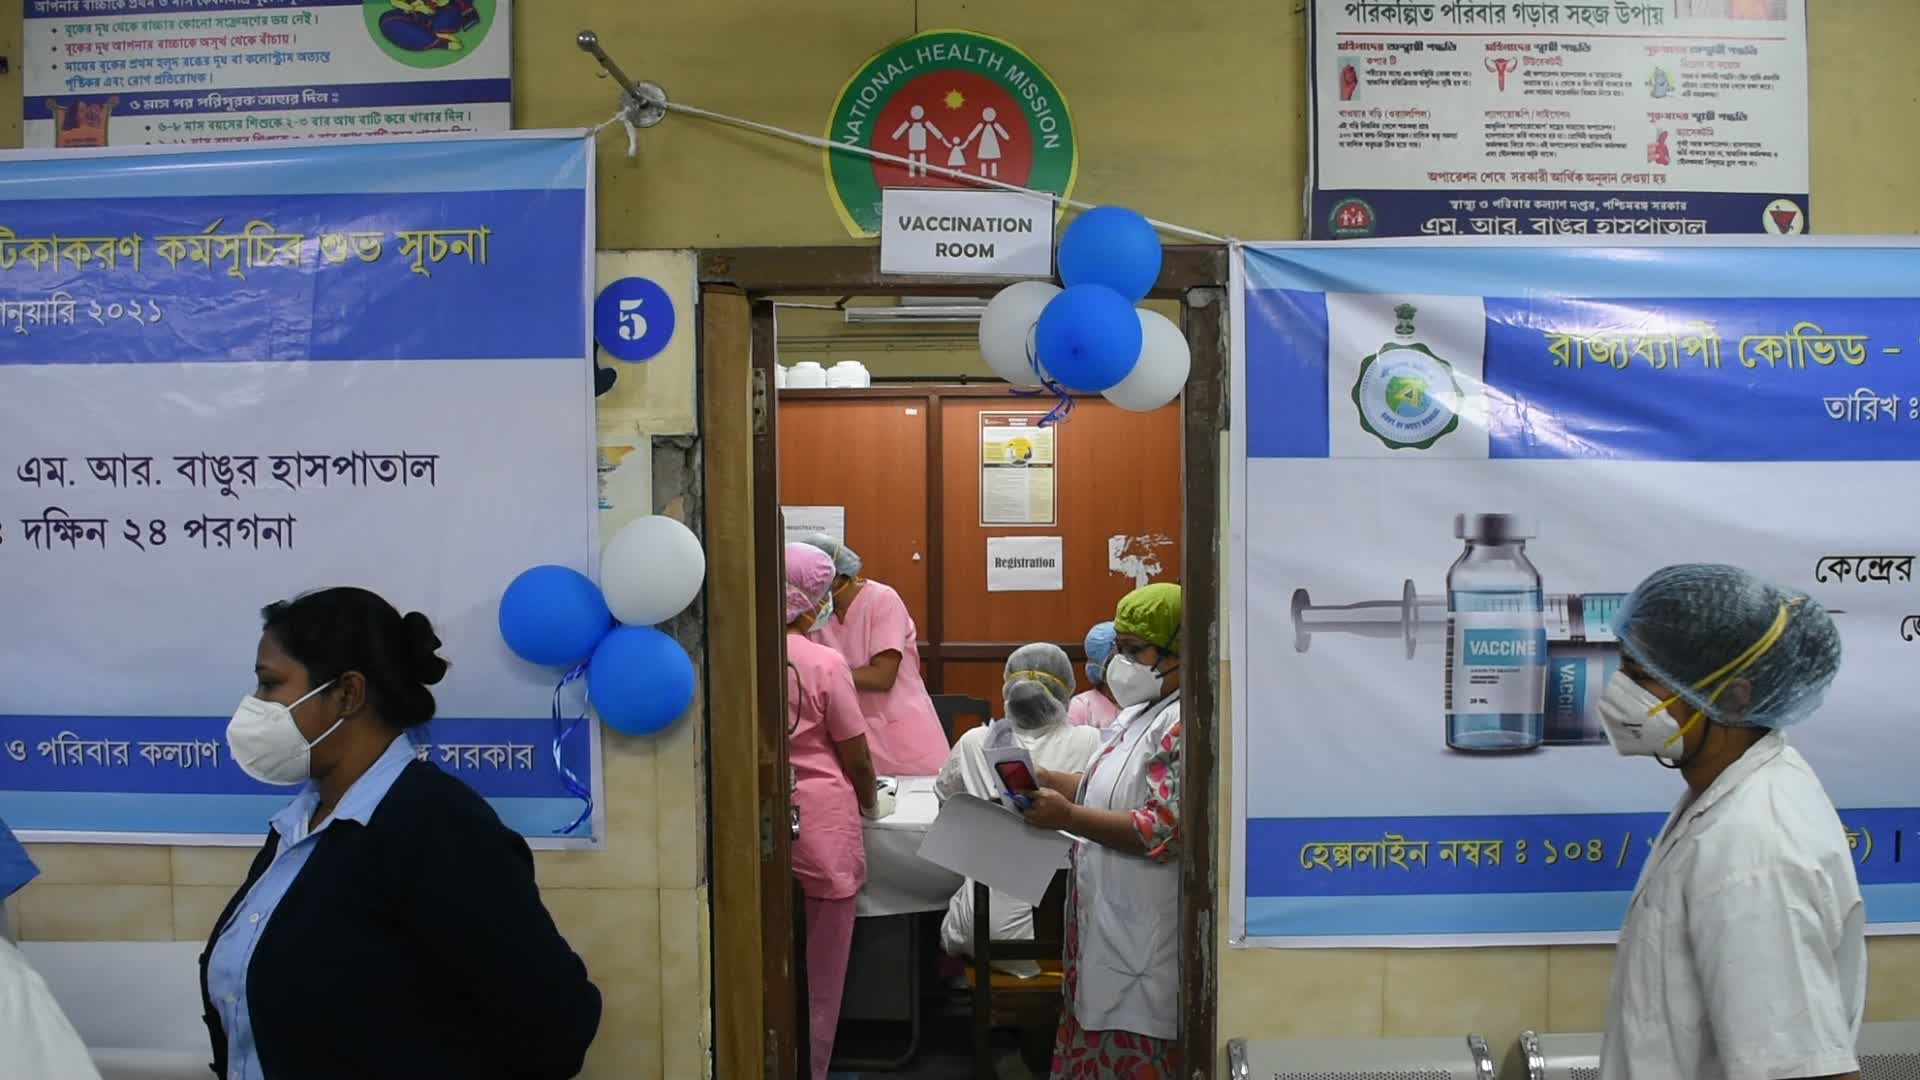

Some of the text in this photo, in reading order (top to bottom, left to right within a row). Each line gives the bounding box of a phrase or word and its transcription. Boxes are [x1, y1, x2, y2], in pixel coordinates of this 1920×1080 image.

[843, 43, 1061, 150] NATIONAL HEALTH MISSION
[898, 216, 1033, 233] VACCINATION
[317, 230, 385, 264] শুভ
[396, 224, 493, 276] সূচনা
[935, 243, 995, 259] ROOM
[87, 299, 164, 326] ২০২১
[619, 299, 647, 340] 5
[1738, 321, 1869, 370] কোভিড
[1823, 387, 1900, 422] তারিখ
[16, 457, 76, 487] এম.
[87, 451, 162, 487] আর.
[268, 449, 440, 491] হাসপাতাল
[123, 518, 167, 551] ২৪
[183, 512, 297, 551] পরগনা
[994, 556, 1056, 570] Registration
[1469, 640, 1537, 657] VACCINE
[5, 740, 27, 761] ও
[37, 730, 130, 767] পরিবার
[138, 738, 219, 768] কল্যাণ
[437, 741, 535, 771] সরকার
